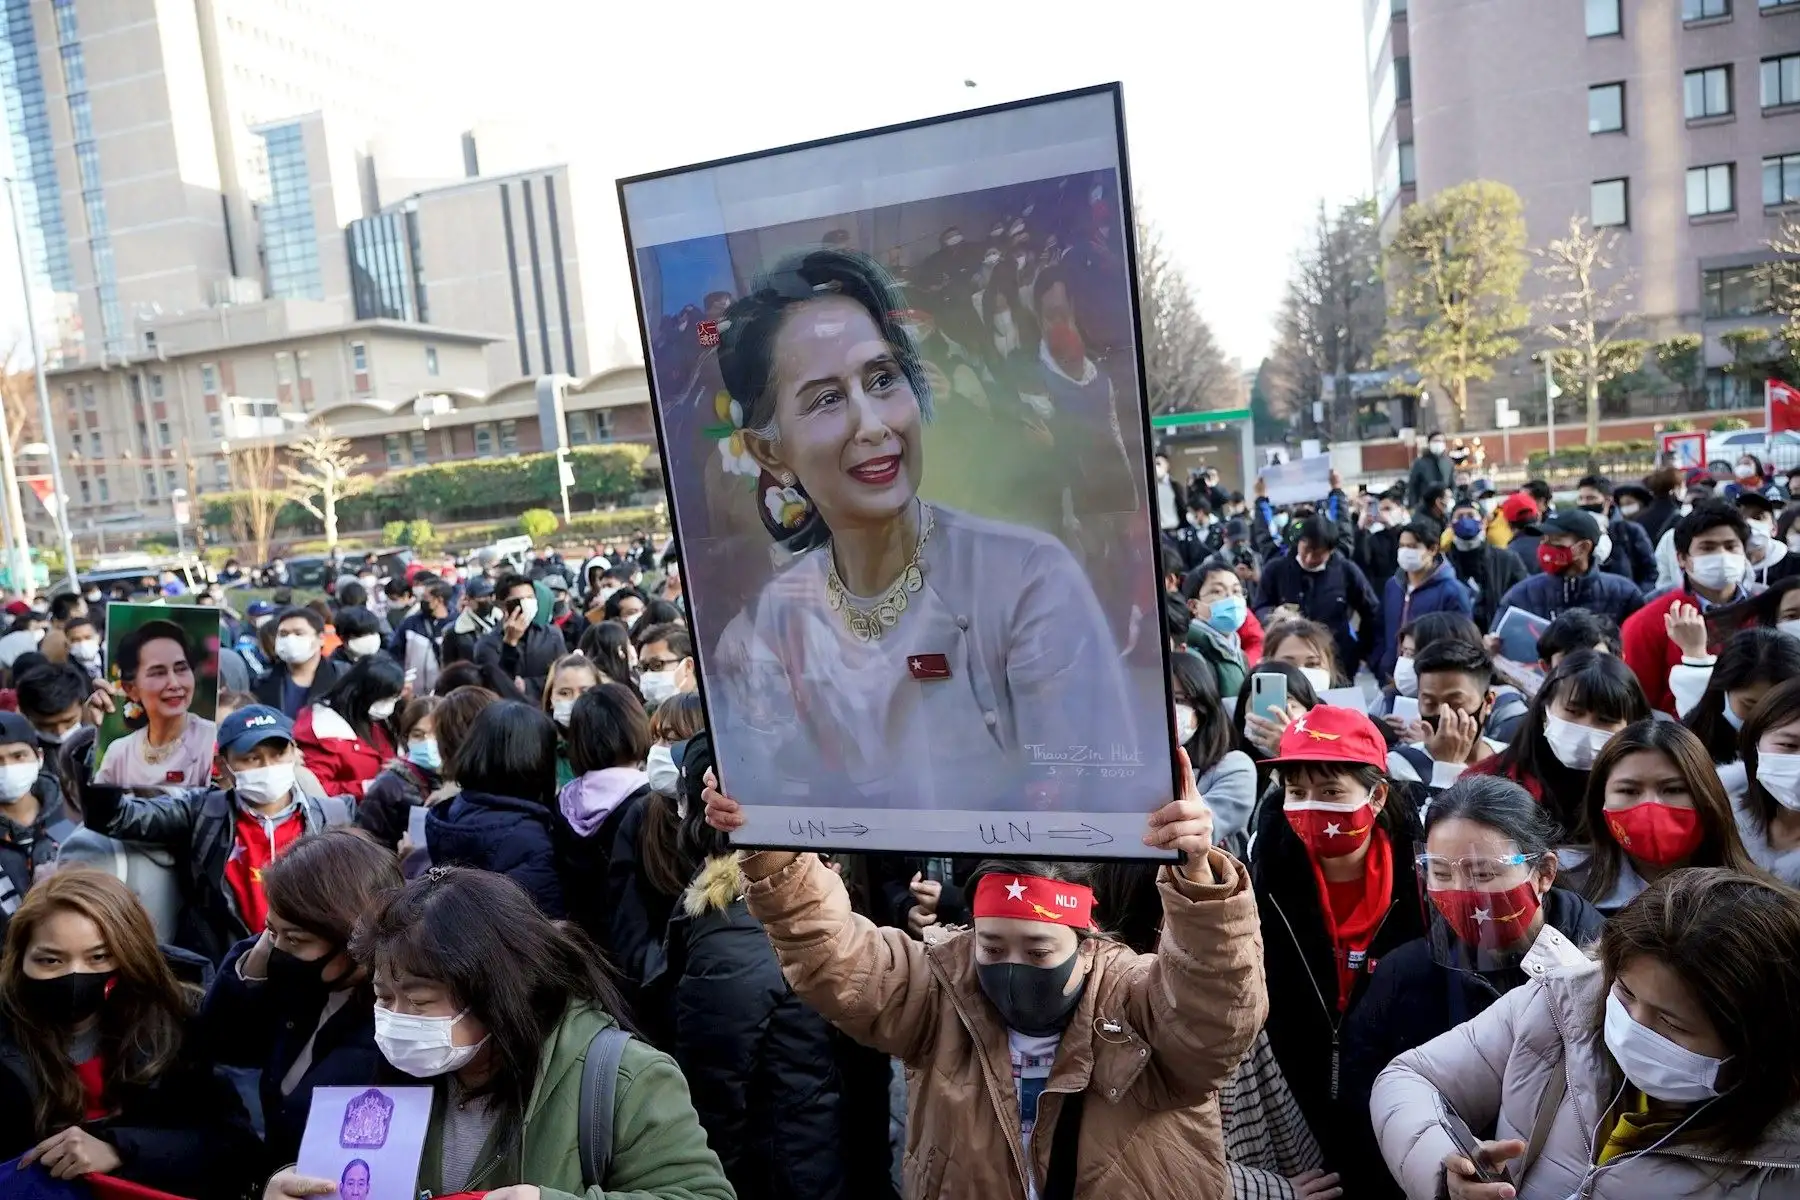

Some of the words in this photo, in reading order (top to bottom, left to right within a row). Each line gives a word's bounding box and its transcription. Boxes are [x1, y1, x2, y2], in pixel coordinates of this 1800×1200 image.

[245, 715, 277, 729] FILA
[1024, 743, 1067, 761] Thaw
[1069, 745, 1104, 762] Zin
[789, 819, 825, 840] UN
[979, 821, 1031, 845] UN
[1055, 893, 1078, 909] NLD
